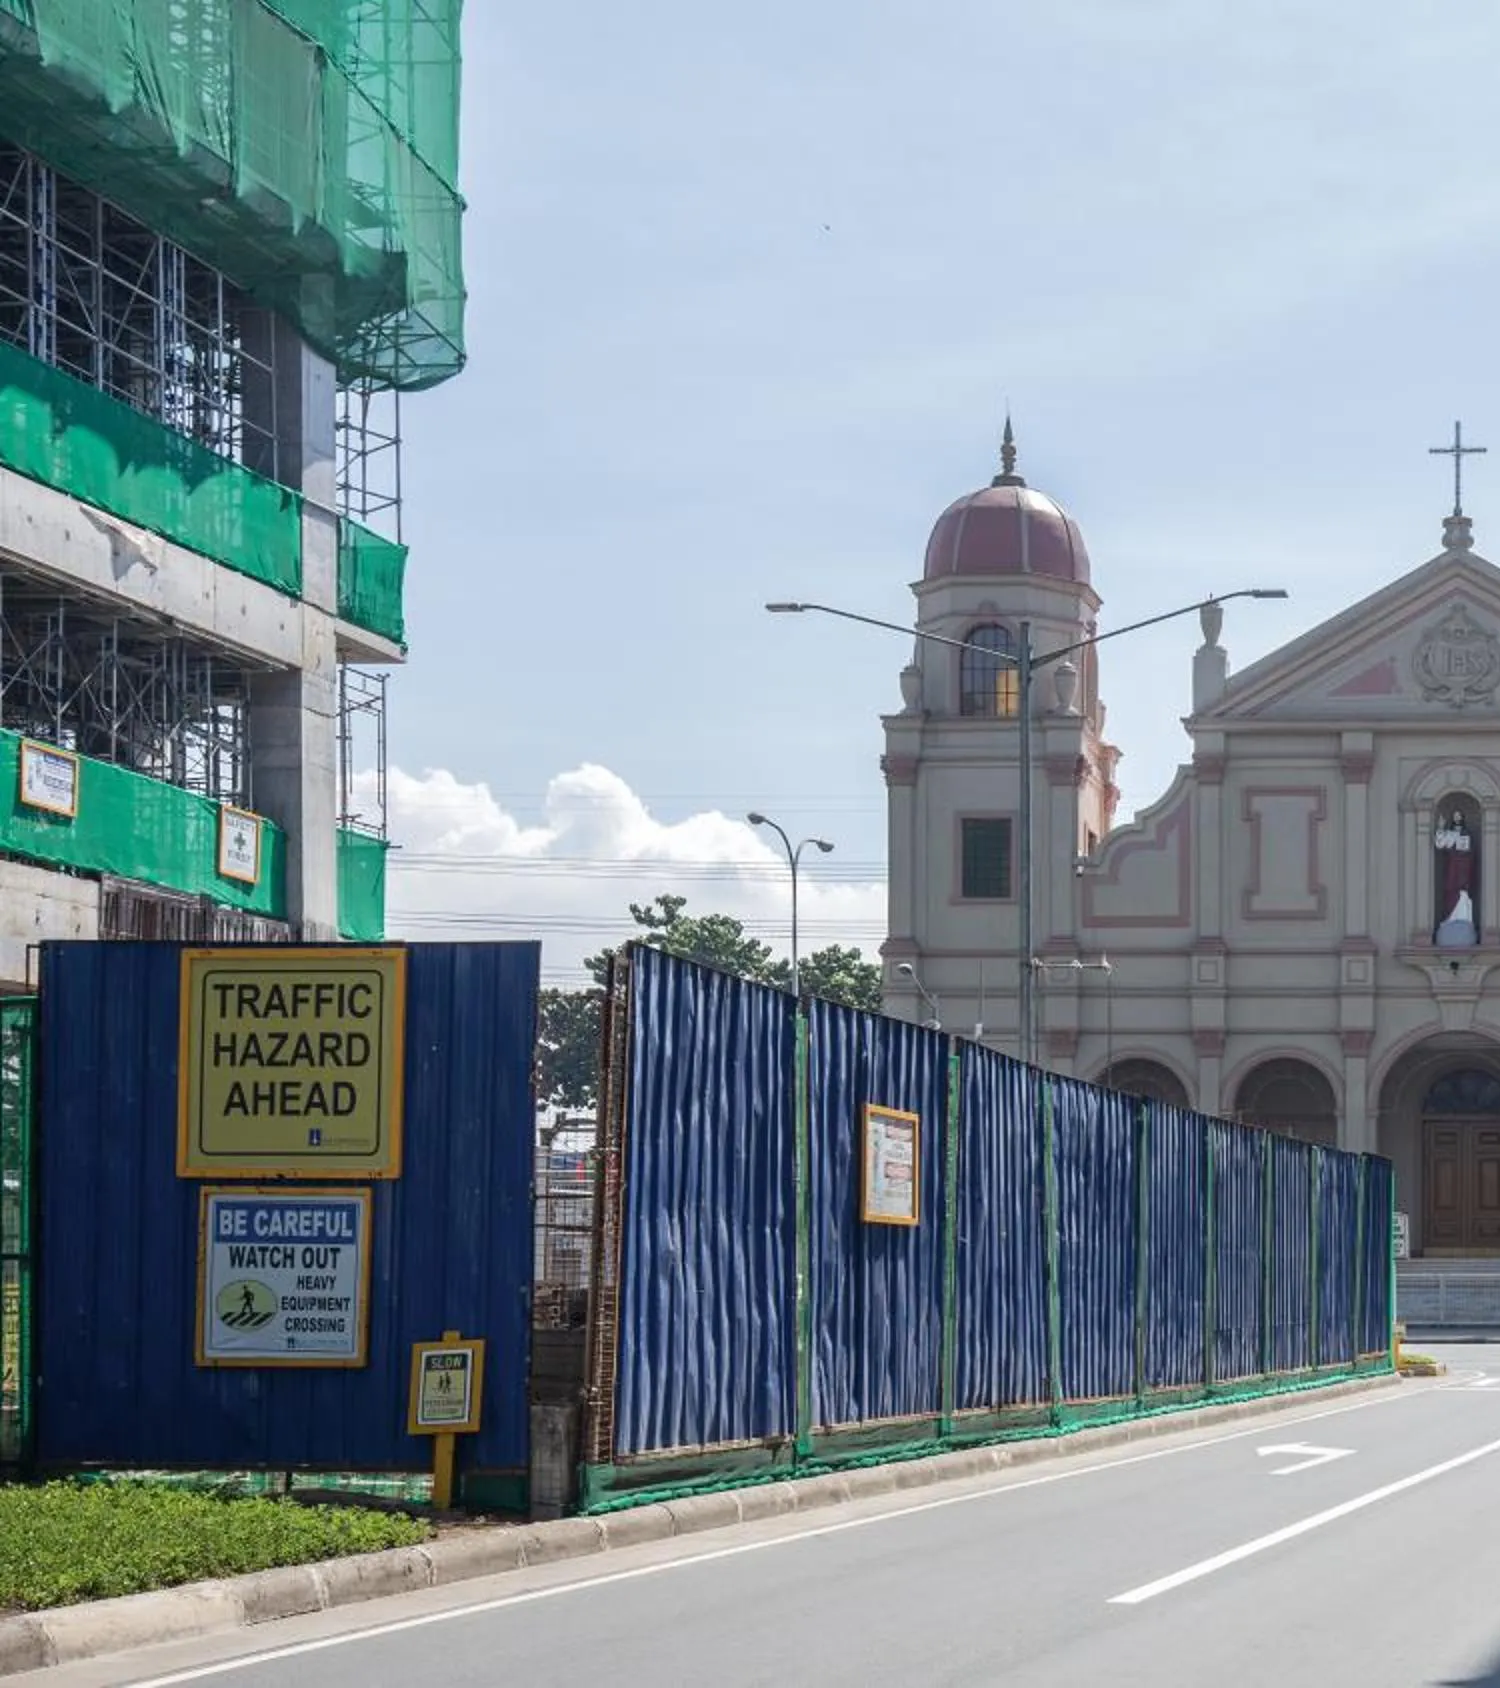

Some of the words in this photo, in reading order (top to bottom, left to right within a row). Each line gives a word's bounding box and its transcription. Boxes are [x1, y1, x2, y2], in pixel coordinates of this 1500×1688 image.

[212, 983, 373, 1019] TRAFFIC
[213, 1032, 371, 1068] HAZARD
[223, 1081, 358, 1117] AHEAD
[219, 1209, 248, 1236] BE
[253, 1209, 353, 1237] CAREFUL
[228, 1246, 295, 1269] WATCH
[301, 1247, 341, 1269] OUT
[296, 1275, 337, 1291] HEAVY
[281, 1296, 350, 1311] EQUIPMENT
[285, 1316, 345, 1333] CROSSING
[431, 1355, 463, 1369] SLOW
